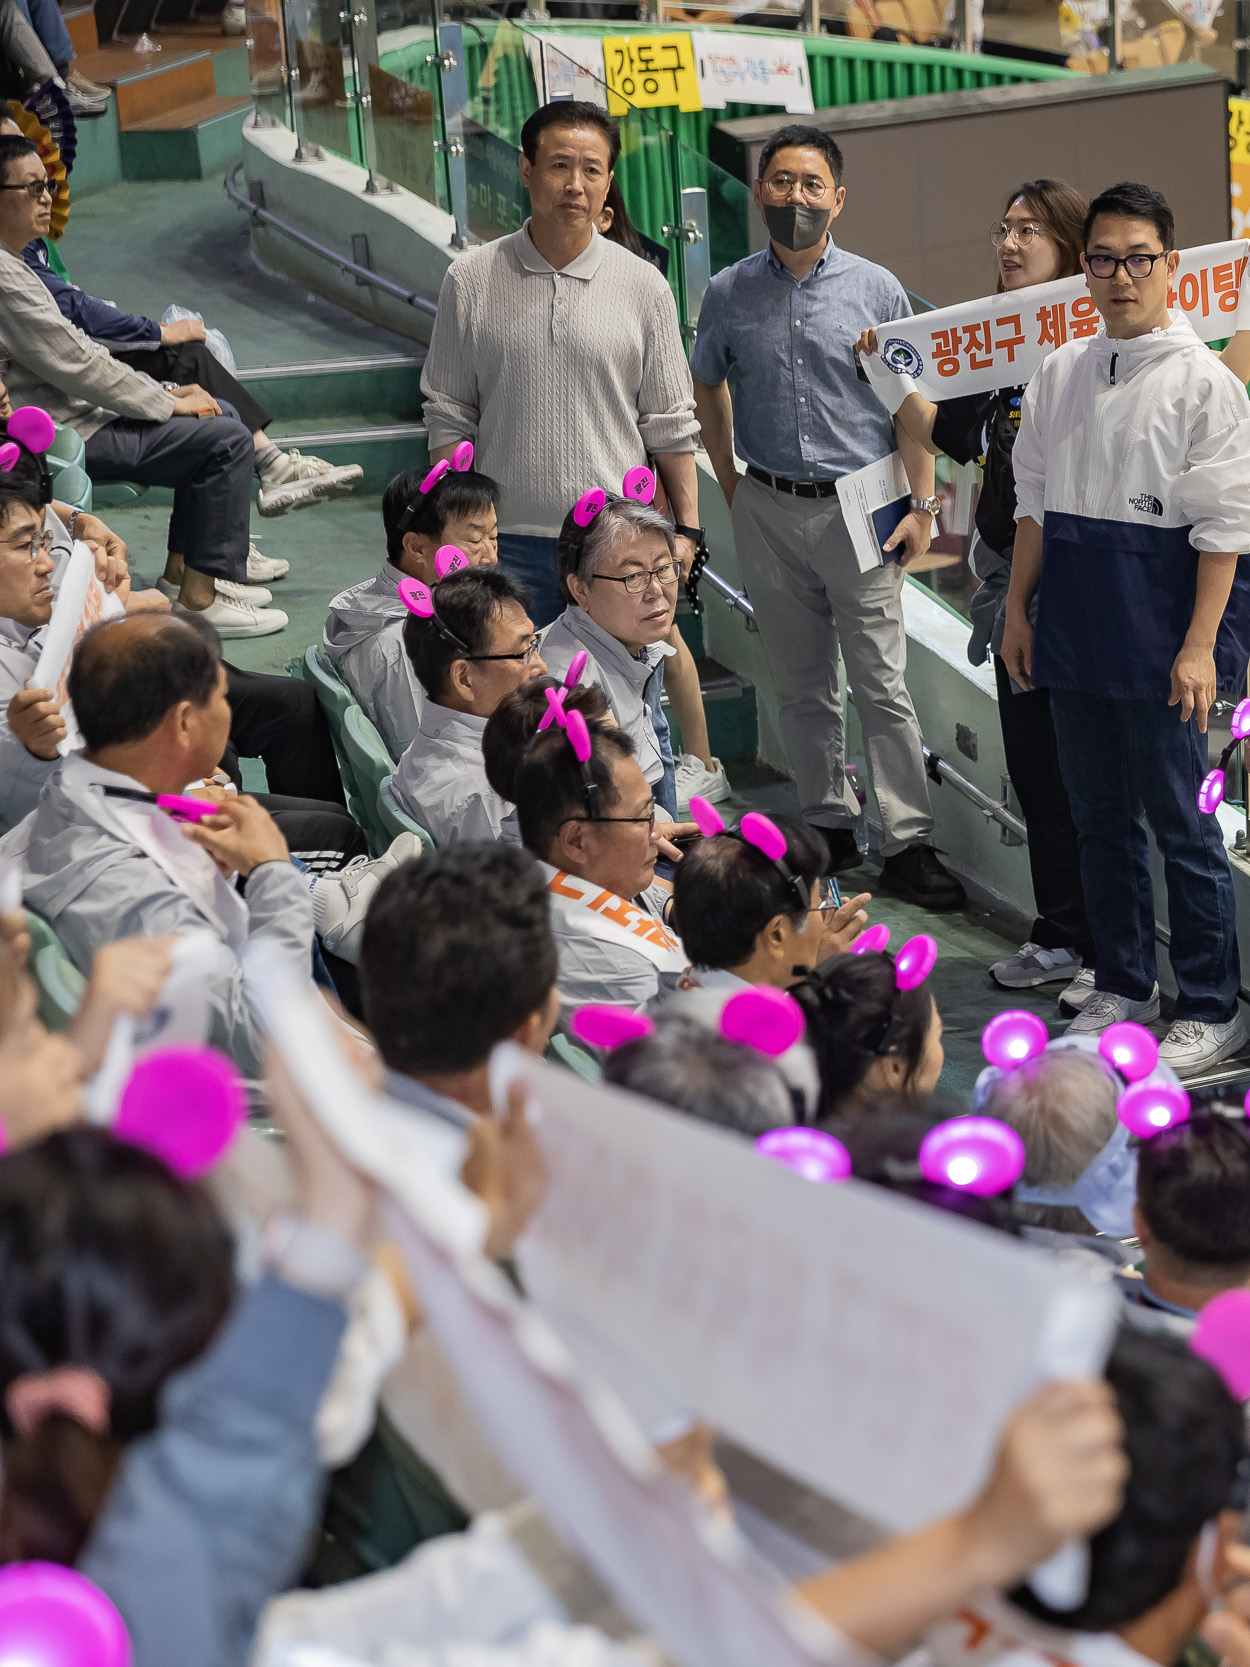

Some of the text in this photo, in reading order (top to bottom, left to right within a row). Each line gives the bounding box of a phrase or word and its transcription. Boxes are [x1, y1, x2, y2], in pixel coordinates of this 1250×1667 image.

[614, 45, 685, 96] 강동구
[930, 313, 1026, 378] 광진구
[1129, 497, 1153, 507] NORTH
[1139, 493, 1154, 501] THE
[1134, 504, 1152, 513] FACE
[409, 590, 428, 601] 광진
